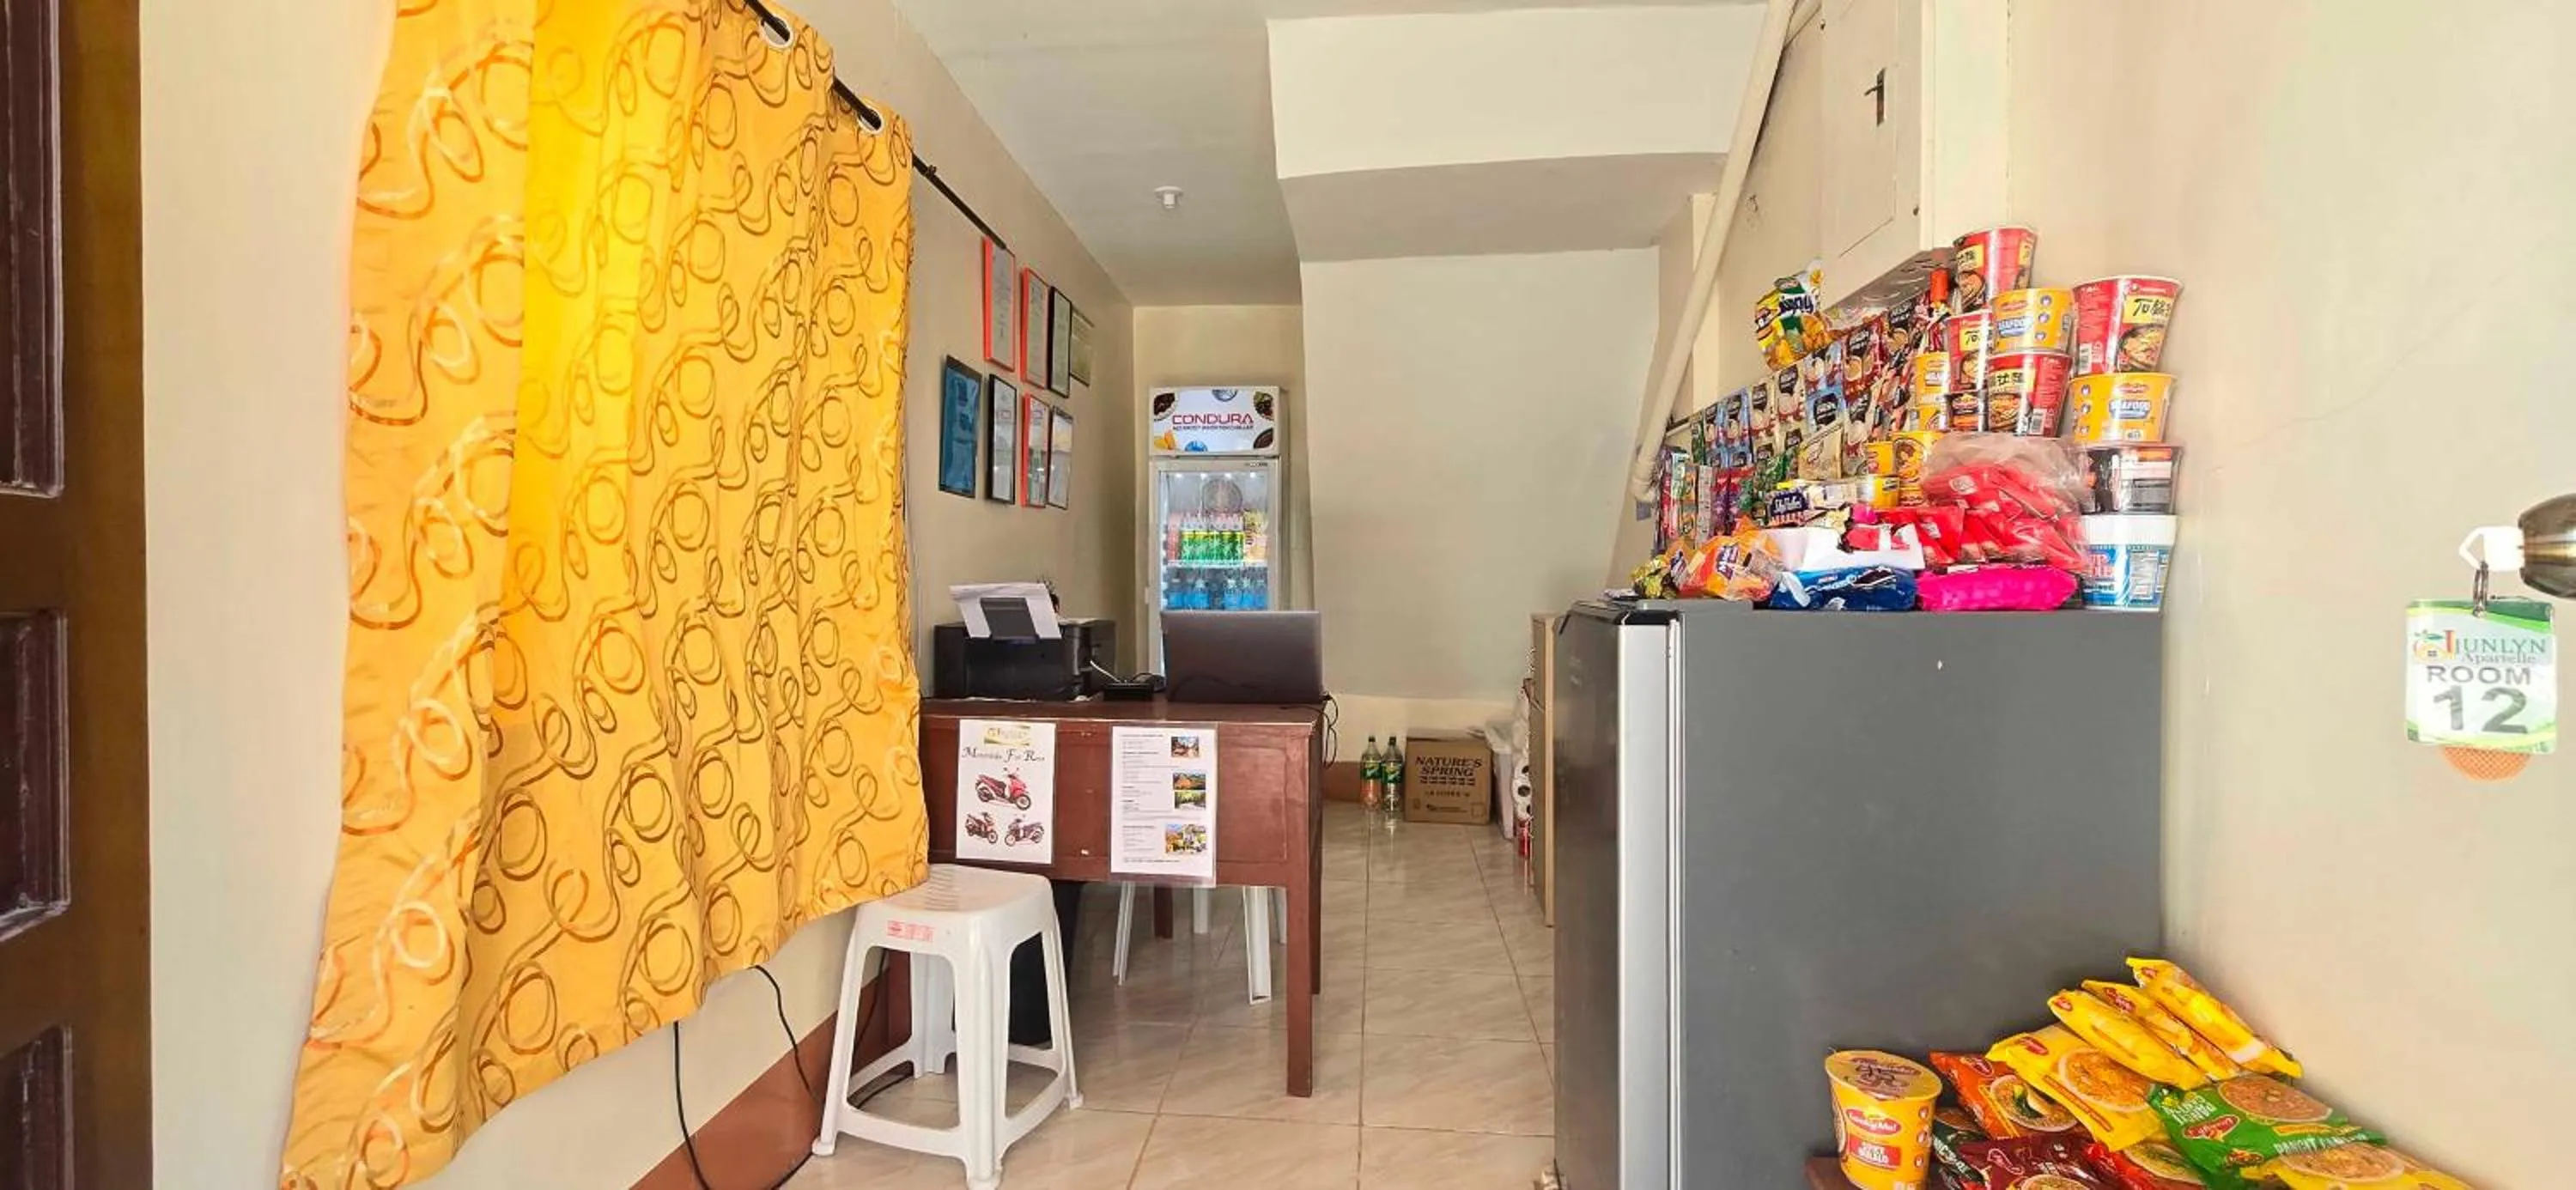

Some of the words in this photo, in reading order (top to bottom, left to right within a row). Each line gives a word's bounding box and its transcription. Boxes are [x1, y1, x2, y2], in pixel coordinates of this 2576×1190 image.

[1172, 413, 1254, 425] CONDURA
[2427, 665, 2531, 685] ROOM
[2433, 685, 2528, 734] 12
[1420, 766, 1474, 777] SPRING
